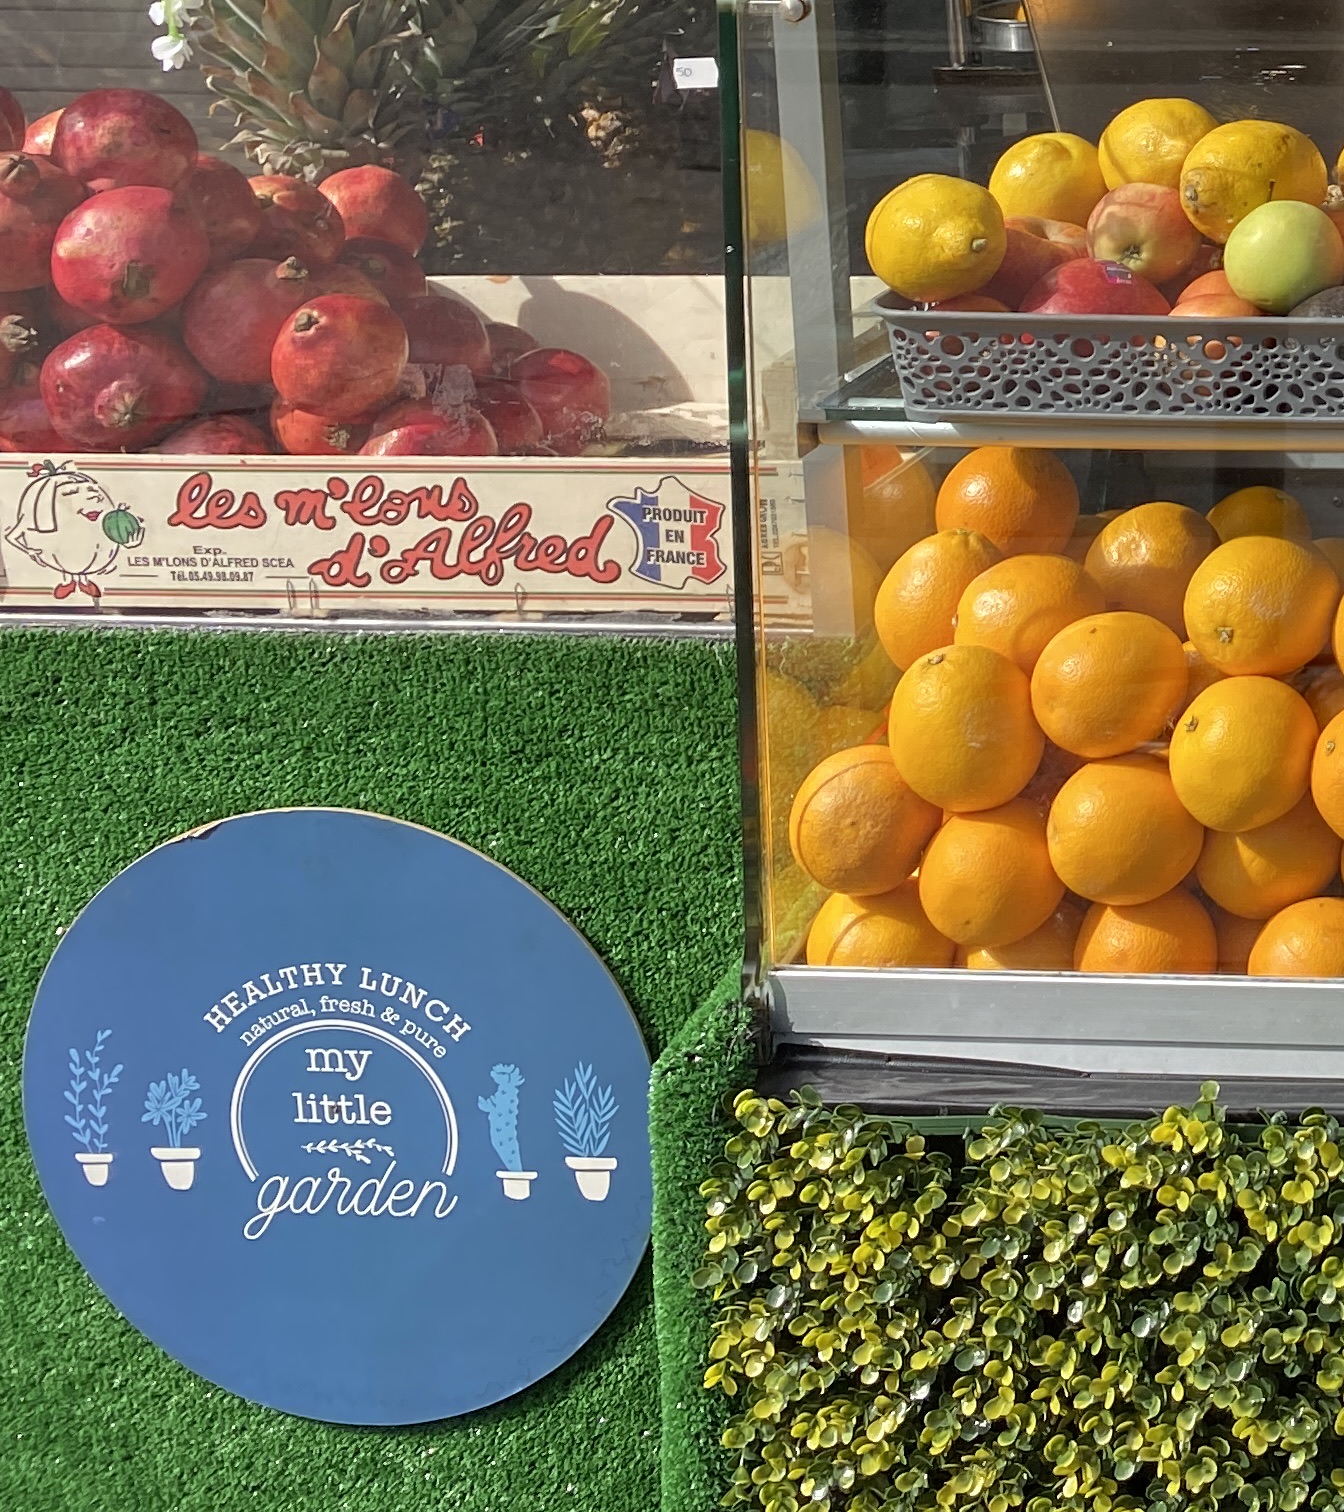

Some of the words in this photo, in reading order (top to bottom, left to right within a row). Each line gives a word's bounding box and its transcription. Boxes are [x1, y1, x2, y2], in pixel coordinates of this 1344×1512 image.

[168, 471, 266, 529] les
[275, 475, 479, 530] m'lons
[642, 504, 708, 526] PRODUIT
[193, 545, 228, 556] Exp.
[307, 503, 622, 587] d'Alfred
[664, 529, 685, 545] EN
[127, 557, 150, 566] LES
[200, 557, 259, 567] D'ALFRED
[262, 558, 295, 568] SCEA
[646, 548, 707, 568] FRANCE
[203, 962, 347, 1034] HEALTHY
[358, 967, 473, 1042] LUNCH
[239, 996, 317, 1049] natural,
[319, 995, 375, 1017] fresh
[380, 1005, 400, 1025] &
[399, 1016, 448, 1060] pure
[305, 1045, 373, 1081] my
[293, 1093, 392, 1126] little
[243, 1161, 459, 1240] garden
